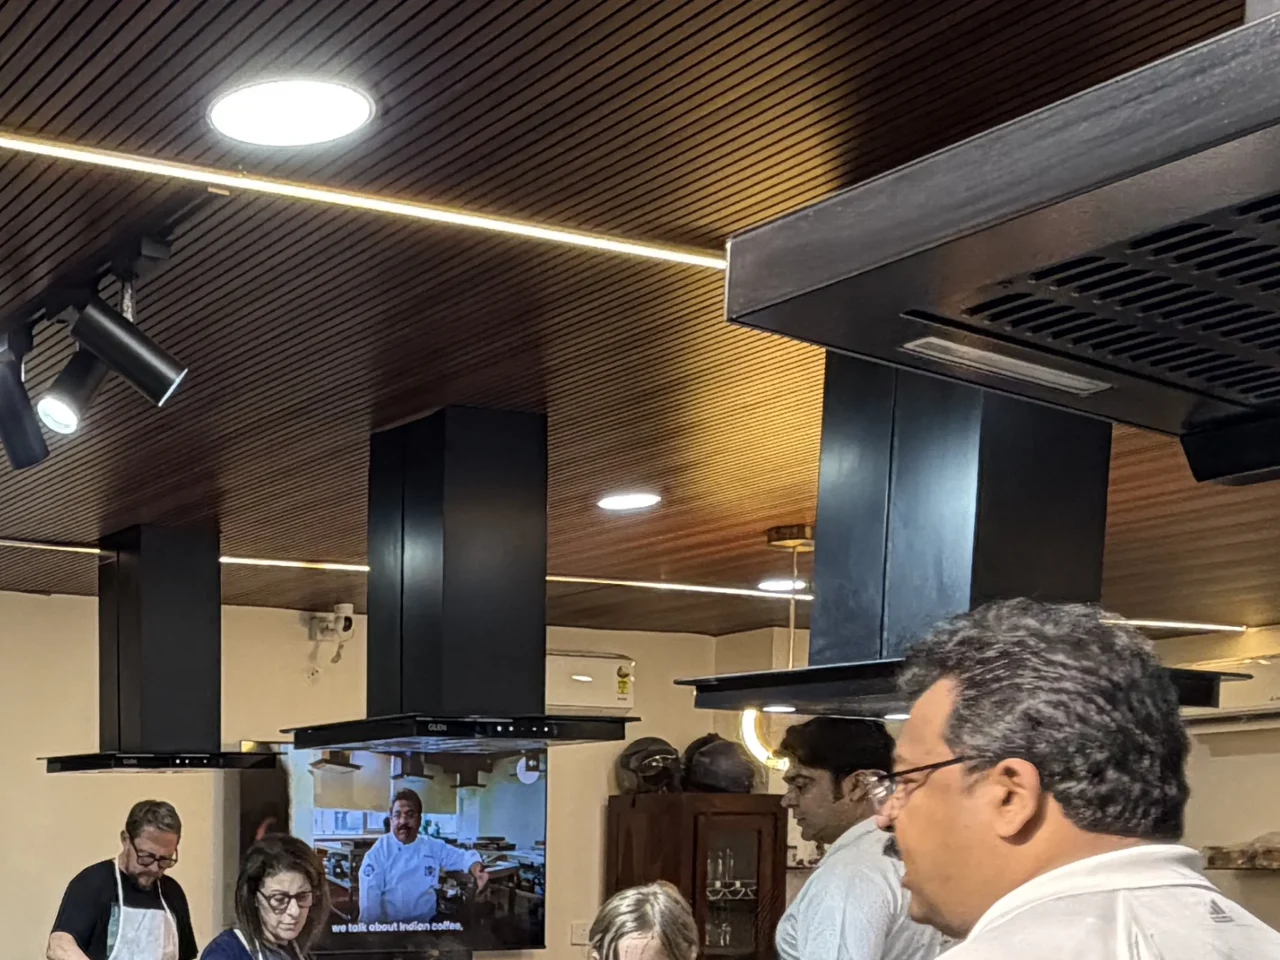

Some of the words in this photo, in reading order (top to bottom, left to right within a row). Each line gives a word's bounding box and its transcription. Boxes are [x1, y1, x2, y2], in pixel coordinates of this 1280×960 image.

[332, 924, 346, 932] we
[348, 922, 368, 932] talk
[368, 921, 398, 931] about
[399, 920, 430, 931] Indian
